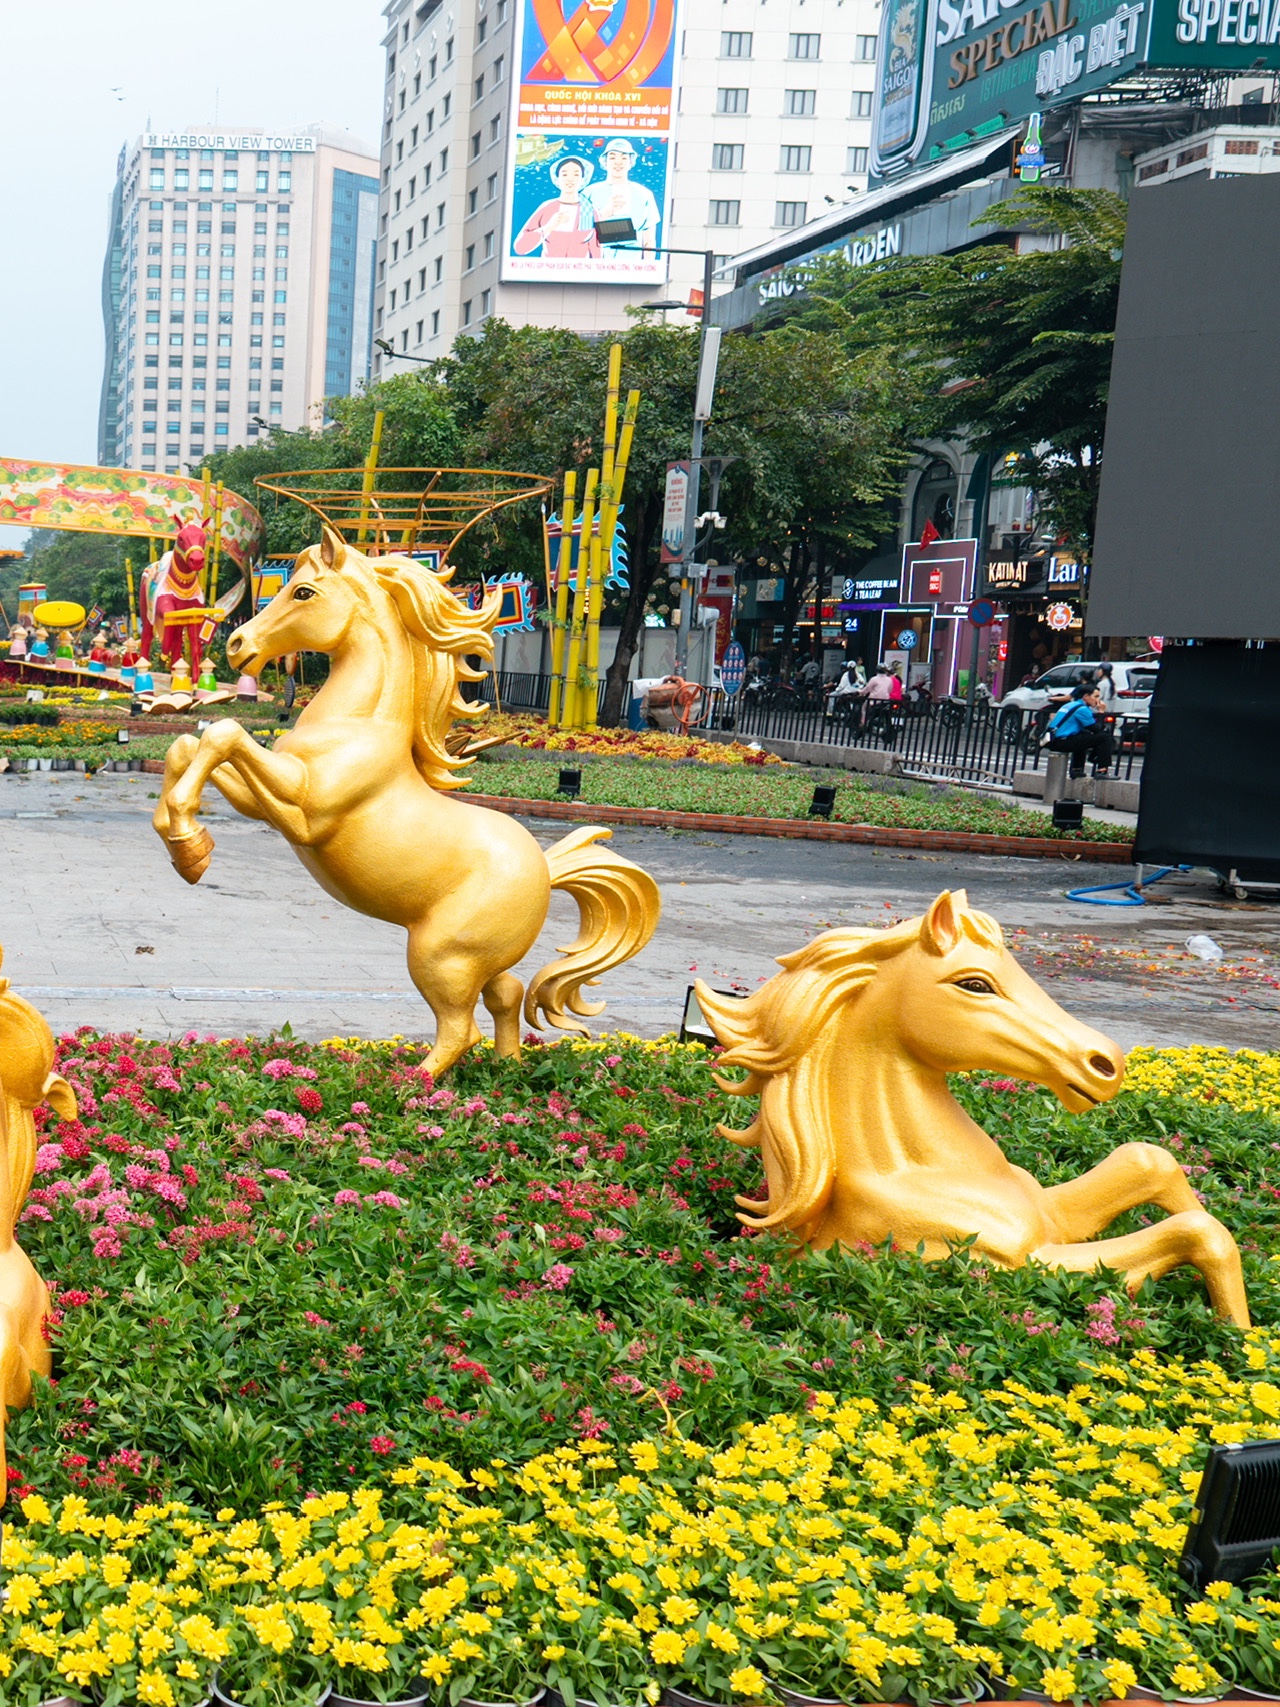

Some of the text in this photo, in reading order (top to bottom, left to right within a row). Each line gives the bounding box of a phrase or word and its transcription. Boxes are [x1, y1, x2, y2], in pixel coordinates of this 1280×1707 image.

[948, 0, 1078, 90] SPECIAL
[1035, 2, 1145, 96] ĐẶC BIỆT
[545, 88, 641, 101] QUỐC HỘI KHÓA XVI
[162, 135, 225, 148] HARBOUR
[229, 136, 262, 149] VIEW
[266, 137, 313, 150] TOWER
[856, 579, 898, 589] THE COFFEE BEAN
[859, 590, 868, 599] TEA
[869, 589, 882, 599] LEAF
[845, 618, 858, 628] 24
